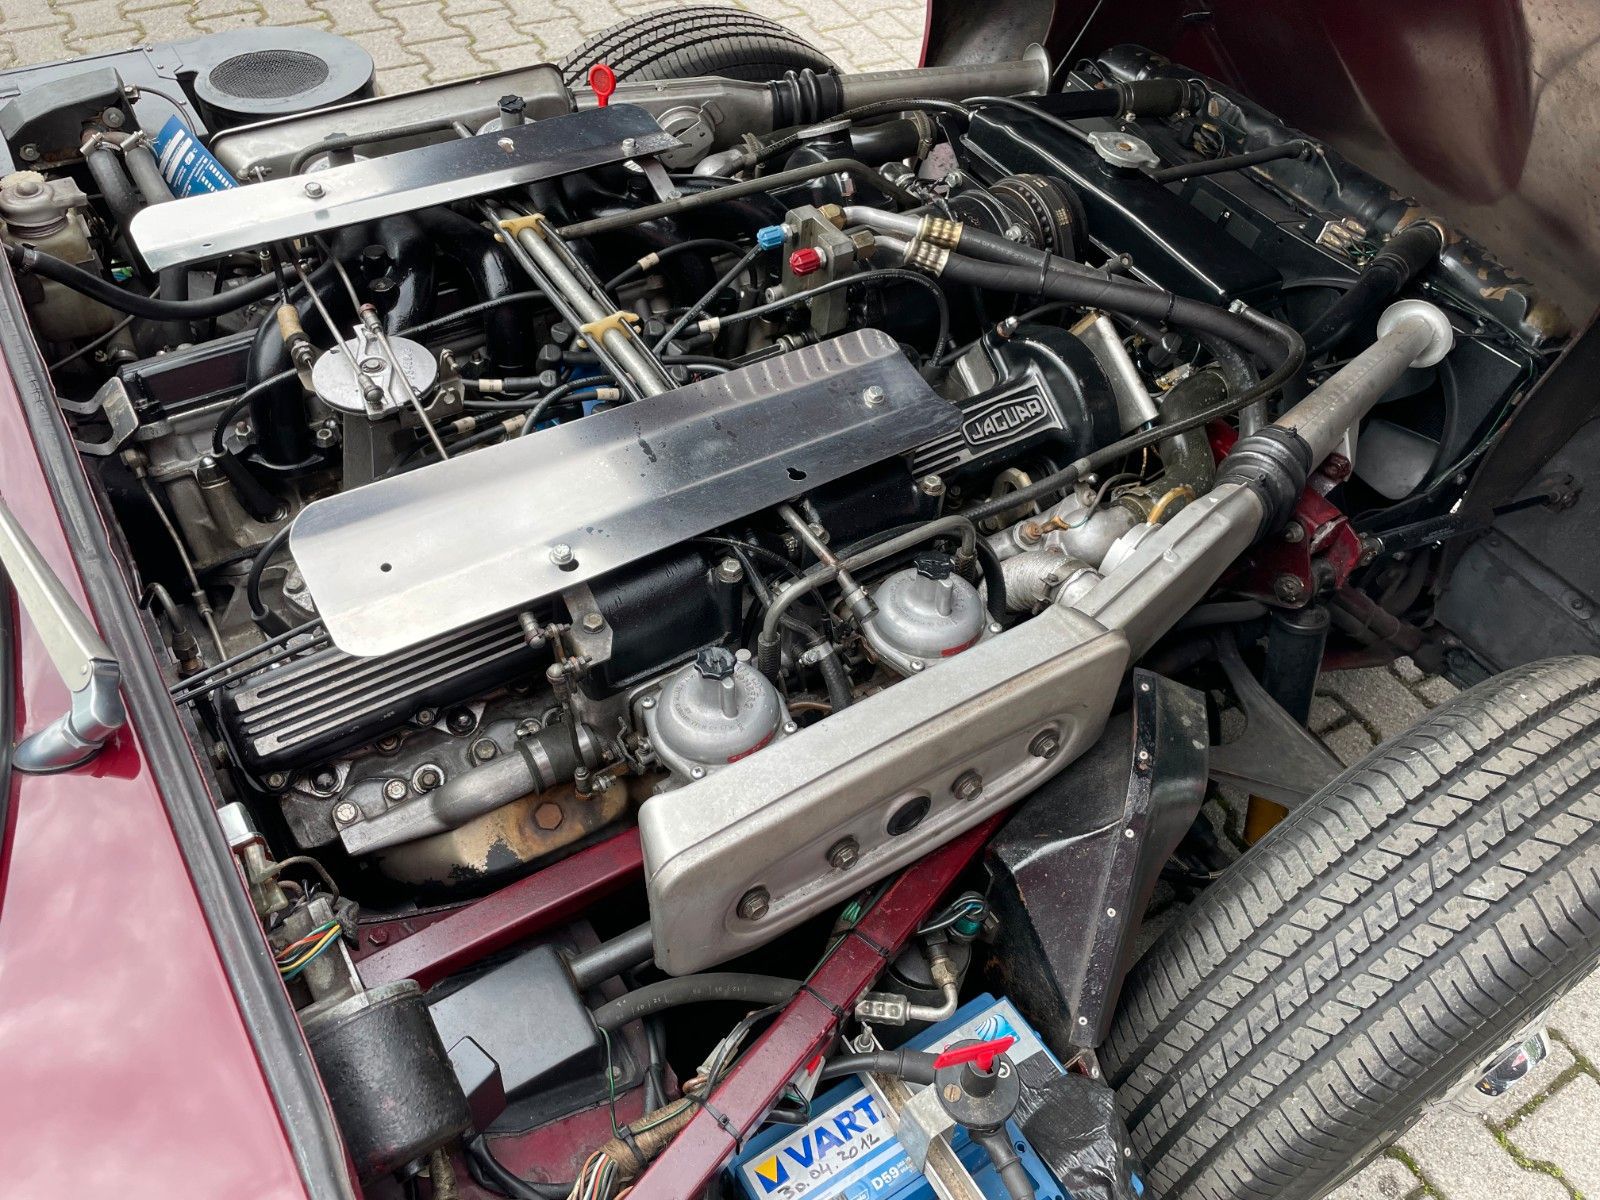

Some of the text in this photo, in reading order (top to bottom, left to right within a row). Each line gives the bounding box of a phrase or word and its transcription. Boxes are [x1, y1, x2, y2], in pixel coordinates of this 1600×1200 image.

[972, 399, 1043, 440] JAGUAR
[783, 1094, 885, 1168] VART
[871, 1166, 899, 1191] D59
